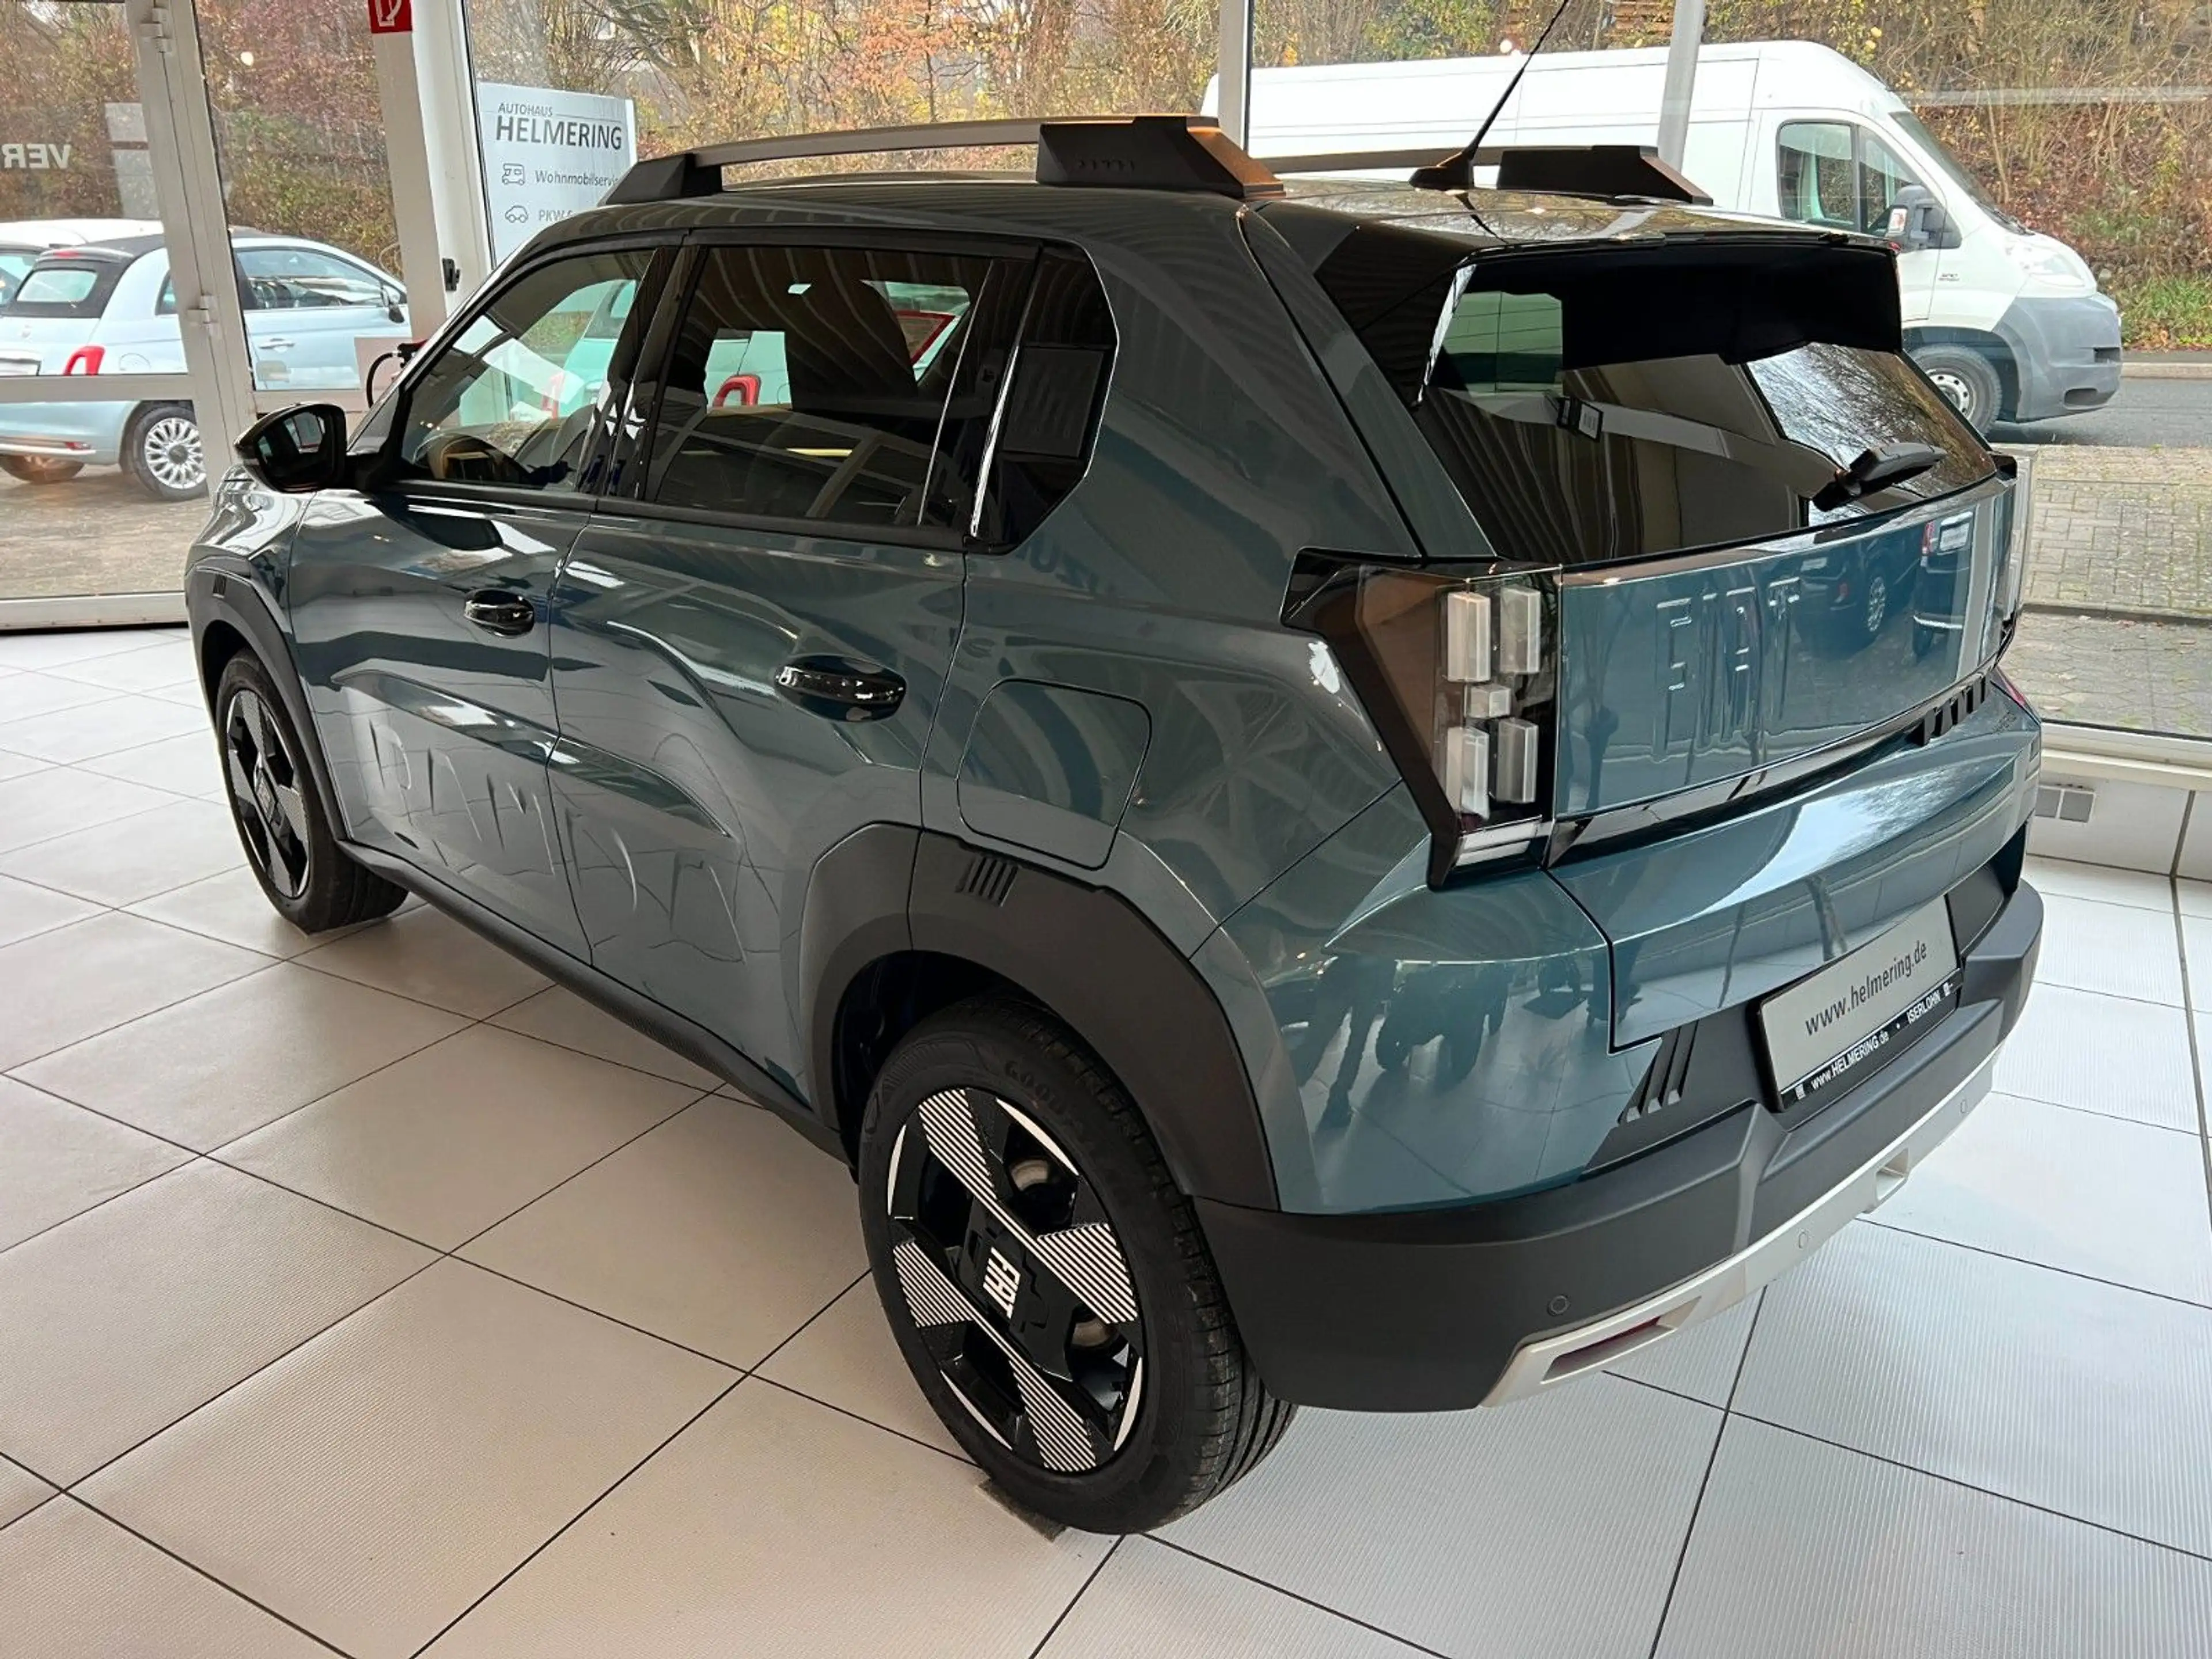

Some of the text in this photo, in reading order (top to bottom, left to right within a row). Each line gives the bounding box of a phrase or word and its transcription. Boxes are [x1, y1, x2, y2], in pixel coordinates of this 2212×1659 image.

[496, 115, 622, 150] HELMERING
[498, 103, 553, 118] AUTOHAUS
[1653, 577, 1801, 760] FIAT
[1805, 940, 1927, 1036] www.helmering.de
[1810, 989, 1941, 1090] www.HELMERING.de ISERLOHN
[983, 1247, 1021, 1319] FIAT
